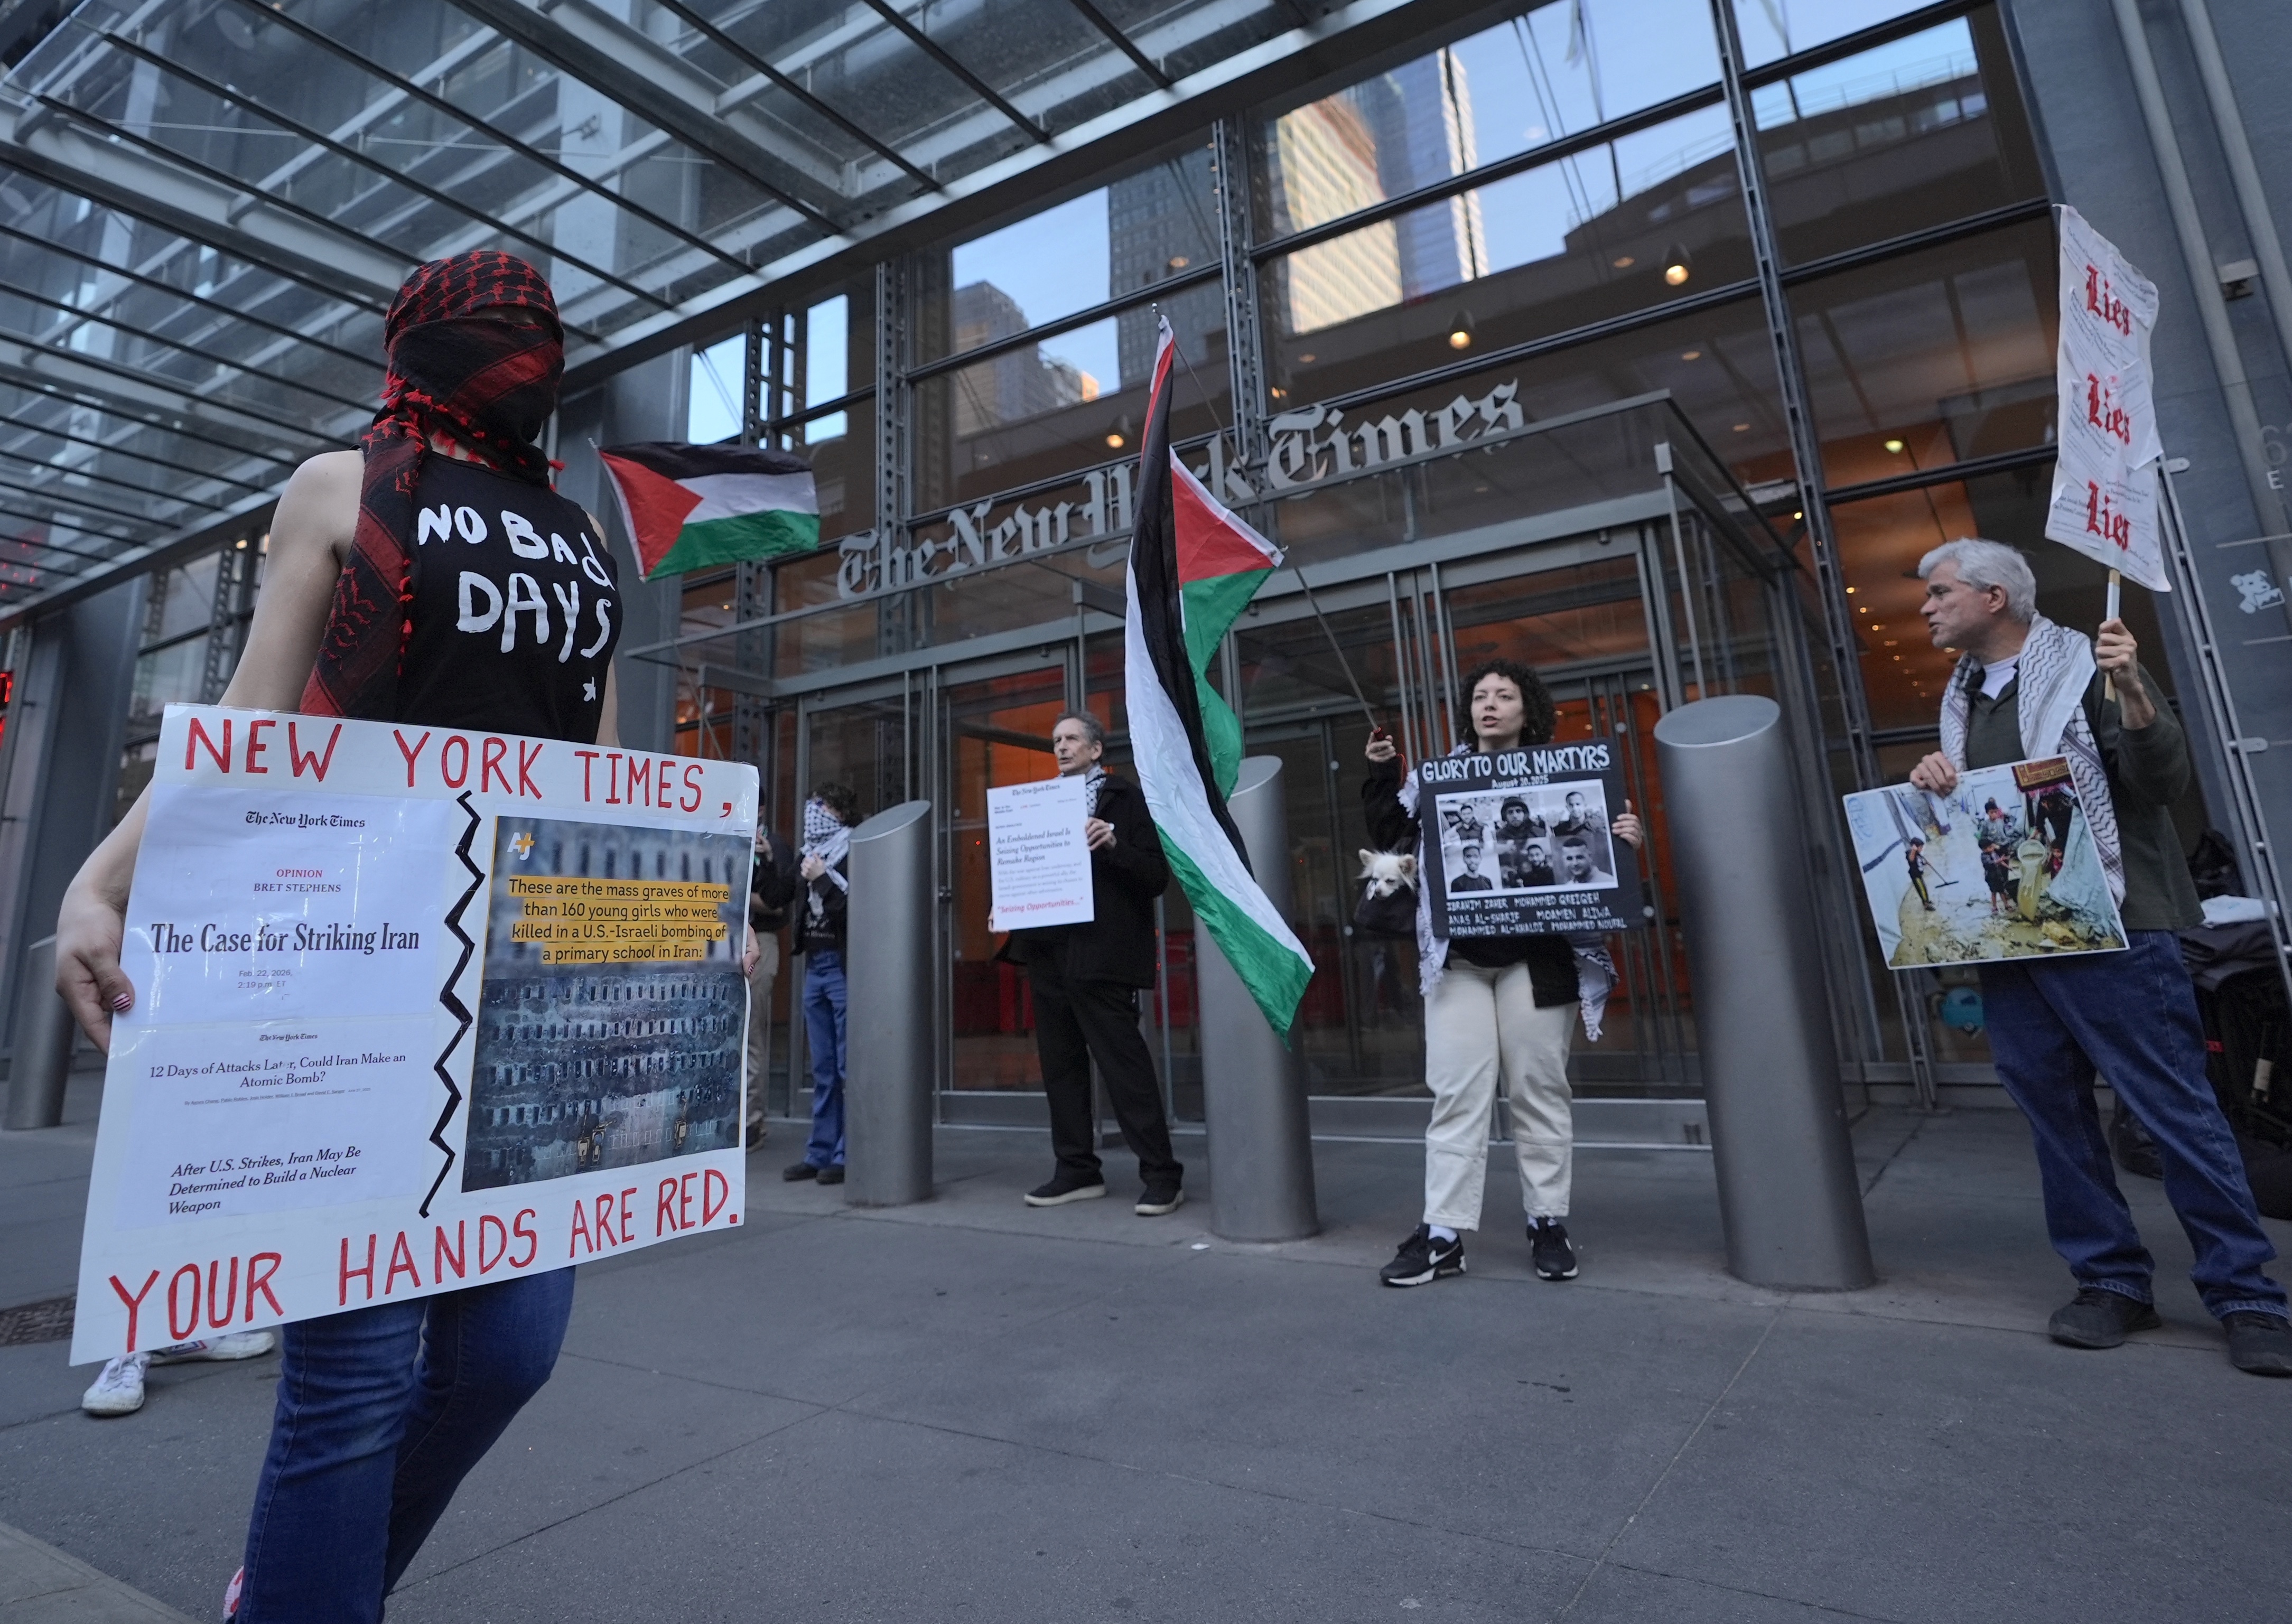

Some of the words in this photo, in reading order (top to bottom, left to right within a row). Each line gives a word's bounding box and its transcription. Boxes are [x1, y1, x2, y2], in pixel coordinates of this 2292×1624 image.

[2086, 265, 2130, 337] Lies
[837, 528, 939, 608] The
[945, 497, 1075, 590] New
[1082, 429, 1259, 570] Yk
[1261, 377, 1525, 498] Times
[417, 503, 488, 546] NO
[2086, 480, 2131, 552] Lies
[455, 571, 612, 663] DAYS
[184, 717, 342, 782] NEW
[393, 729, 543, 800] YORK
[1422, 757, 1470, 782] GLORY
[1469, 755, 1492, 777] TO
[1496, 751, 1531, 776] OUR
[1532, 744, 1610, 774] MARTYRS
[1491, 778, 1519, 789] August
[245, 811, 268, 825] The
[269, 812, 296, 825] New
[297, 814, 329, 829] York
[330, 815, 366, 828] Times
[1007, 830, 1046, 844] Emboldened
[1046, 828, 1065, 840] Israel
[996, 846, 1019, 856] Seizing
[1020, 842, 1063, 854] Opportunities
[997, 856, 1022, 866] Remake
[1023, 854, 1046, 865] Region
[276, 869, 323, 878] OPINION
[254, 883, 283, 892] BRET
[285, 884, 341, 892] STEPHENS
[509, 879, 552, 896] These
[556, 884, 577, 895] are
[581, 881, 603, 895] the
[606, 885, 639, 897] mass
[642, 888, 685, 901] graves
[687, 885, 698, 898] of
[701, 889, 729, 899] more
[524, 903, 557, 916] than
[561, 902, 585, 917] 160
[588, 905, 628, 921] young
[631, 904, 661, 921] girls
[664, 905, 688, 917] who
[691, 908, 718, 918] were
[1448, 914, 1471, 926] ANAS
[1535, 908, 1577, 921] MOAMEN
[512, 924, 552, 939] killed
[555, 925, 569, 938] in
[571, 928, 580, 938] a
[583, 924, 658, 938] U.S.-Israeli
[661, 925, 712, 942] bombing
[715, 926, 726, 938] of
[1449, 925, 1496, 936] MOHAMMED
[1550, 920, 1596, 931] MOHAMMED
[151, 923, 193, 953] The
[200, 923, 251, 953] Case
[256, 925, 286, 952] for
[292, 923, 376, 955] Striking
[379, 922, 420, 950] Iran
[543, 950, 551, 961] a
[555, 947, 608, 964] primary
[612, 946, 655, 959] school
[658, 946, 670, 958] in
[673, 945, 703, 958] Iran:
[149, 1066, 164, 1078] 12
[166, 1063, 198, 1078] Days
[201, 1061, 214, 1075] of
[215, 1060, 261, 1074] Attacks
[300, 1055, 333, 1068] Could
[336, 1054, 358, 1067] Iran
[360, 1052, 390, 1065] Make
[239, 1074, 284, 1088] Atomic
[285, 1070, 327, 1085] Bomb?
[171, 1164, 206, 1178] After
[209, 1161, 235, 1174] U.S.
[238, 1155, 284, 1171] Strikes,
[287, 1151, 314, 1165] Iran
[315, 1149, 343, 1163] May
[345, 1146, 361, 1159] Be
[168, 1176, 245, 1197] Determined
[248, 1175, 260, 1187] to
[263, 1170, 297, 1186] Build
[309, 1164, 357, 1180] Nuclear
[168, 1198, 221, 1215] Weapon
[108, 1252, 284, 1353] YOUR
[338, 1208, 537, 1306] HANDS
[570, 1187, 637, 1258] ARE
[656, 1169, 738, 1236] RED.
